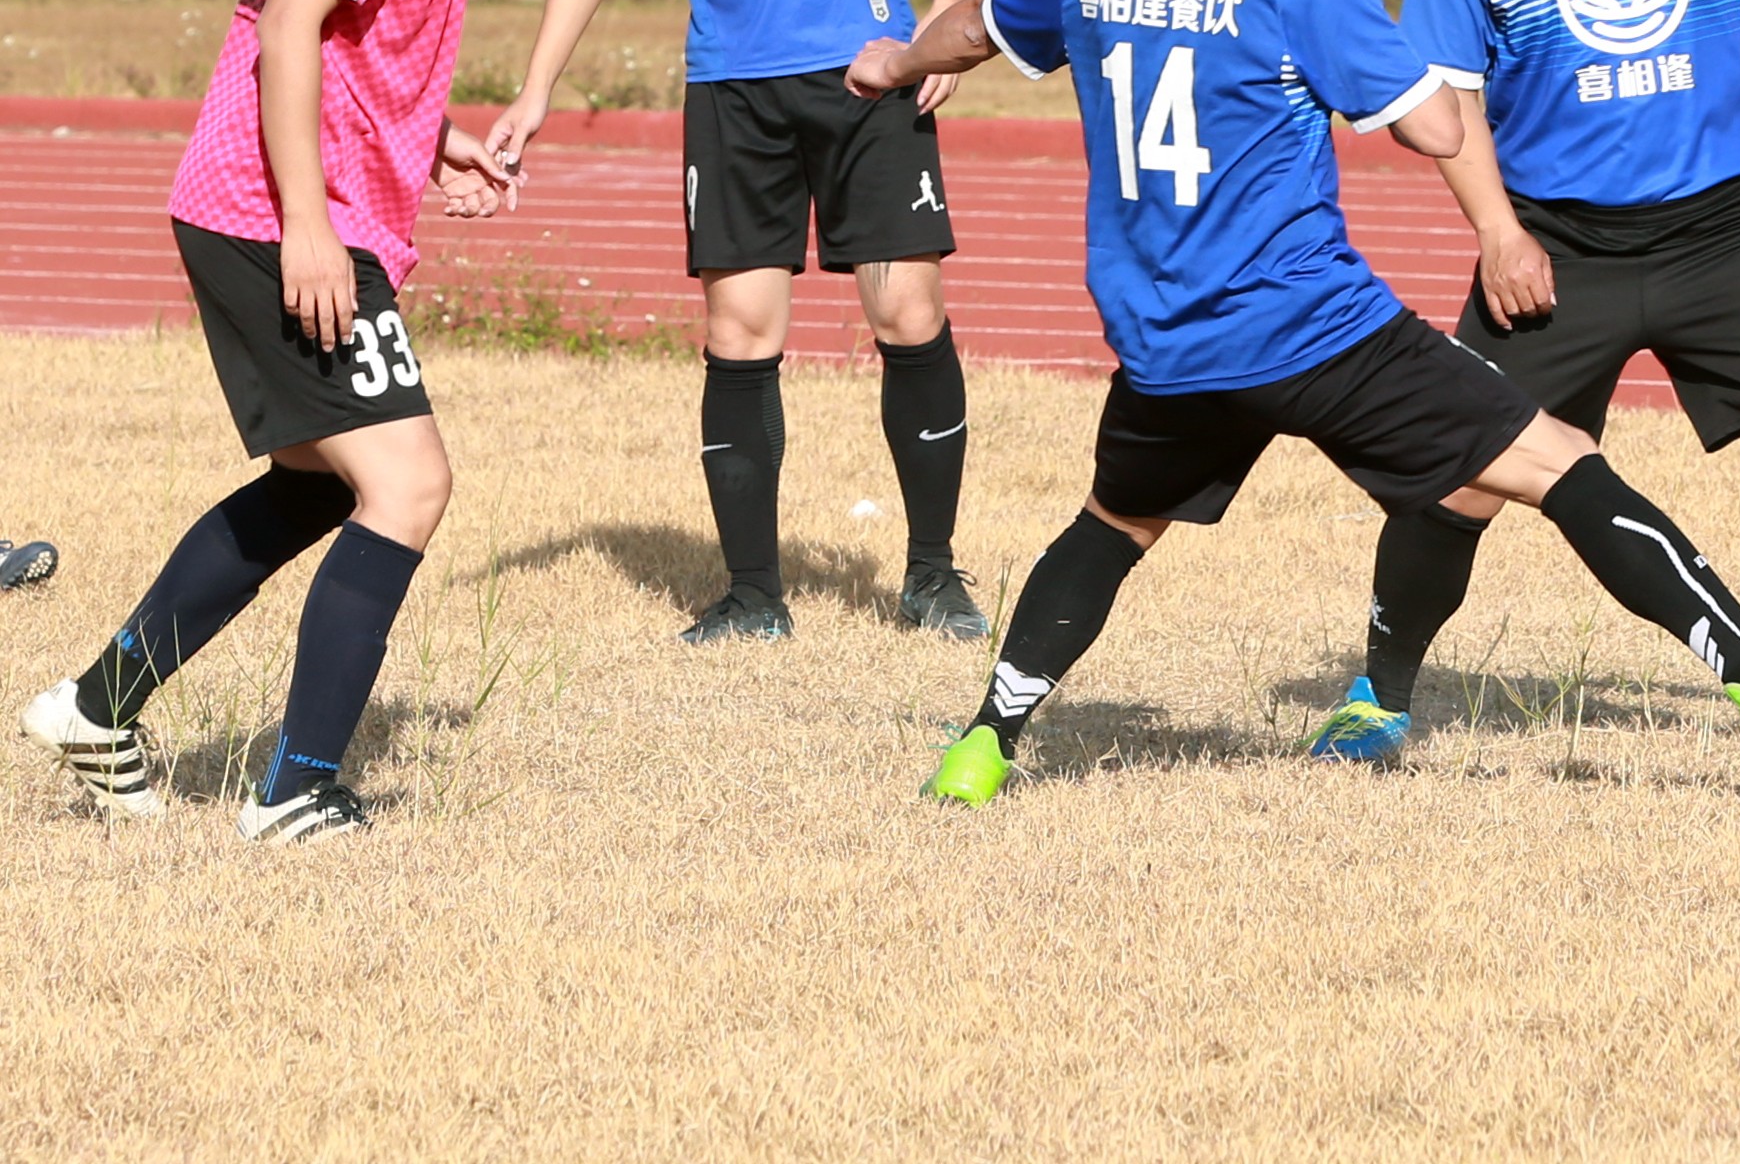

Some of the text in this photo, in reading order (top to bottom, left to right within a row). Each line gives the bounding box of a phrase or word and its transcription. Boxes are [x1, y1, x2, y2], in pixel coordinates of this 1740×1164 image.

[1574, 53, 1696, 104] 喜相逢
[1101, 41, 1212, 207] 14
[347, 309, 421, 398] 33
